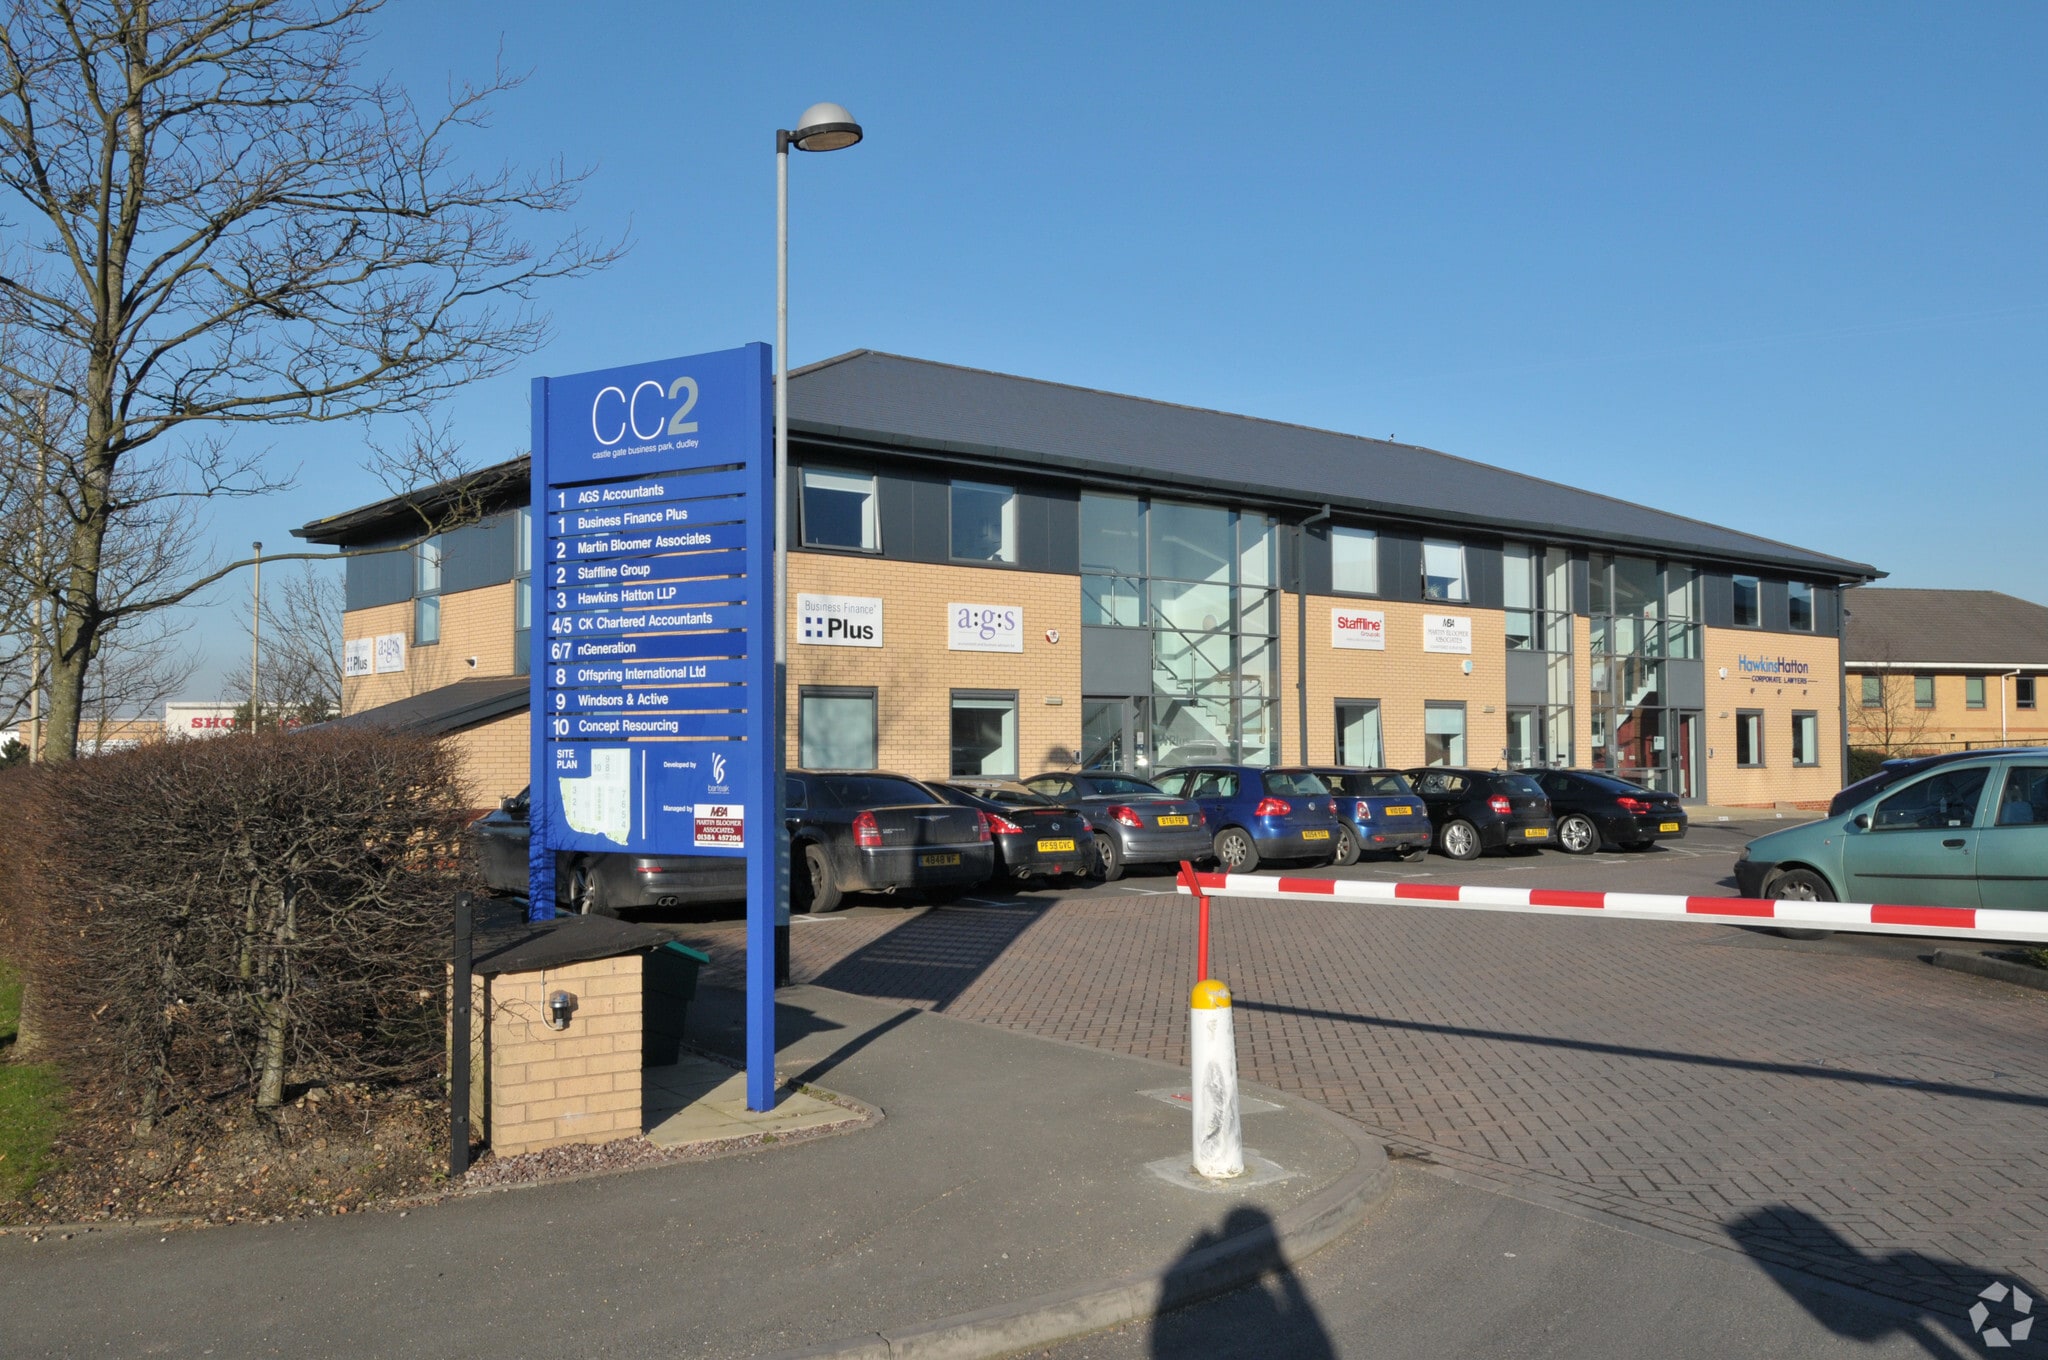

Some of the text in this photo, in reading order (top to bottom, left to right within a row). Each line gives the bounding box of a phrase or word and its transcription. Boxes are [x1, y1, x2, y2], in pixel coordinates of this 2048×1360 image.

[592, 376, 699, 445] CC2
[592, 438, 699, 460] castle gate business park, dudley
[558, 484, 664, 508] 1 AGS Accountants
[558, 508, 688, 534] 1 Business Finance Plus
[556, 532, 712, 559] 2 Martin Bloomer Associates
[556, 564, 650, 584] 2 Staffline Group
[556, 587, 677, 608] 3 Hawkins Hatton LLP
[805, 600, 874, 615] Business Finance
[551, 612, 713, 634] 4/5 CK Chartered Accountants
[828, 617, 874, 640] Plus
[1337, 616, 1381, 632] Staffline
[551, 641, 636, 660] 6/7 nGeneration
[353, 656, 368, 671] Plus
[556, 666, 706, 685] 8 Offspring International Ltd
[1751, 675, 1808, 685] CORPORATE LAWYERS
[556, 693, 669, 710] 9 Windsors & Active
[553, 718, 679, 735] 10 Concept Resourcing
[556, 749, 574, 758] SITE
[556, 760, 577, 769] PLAN
[690, 761, 696, 769] by
[663, 805, 686, 813] Managed
[710, 806, 728, 817] MBA
[696, 819, 715, 827] MARTIN
